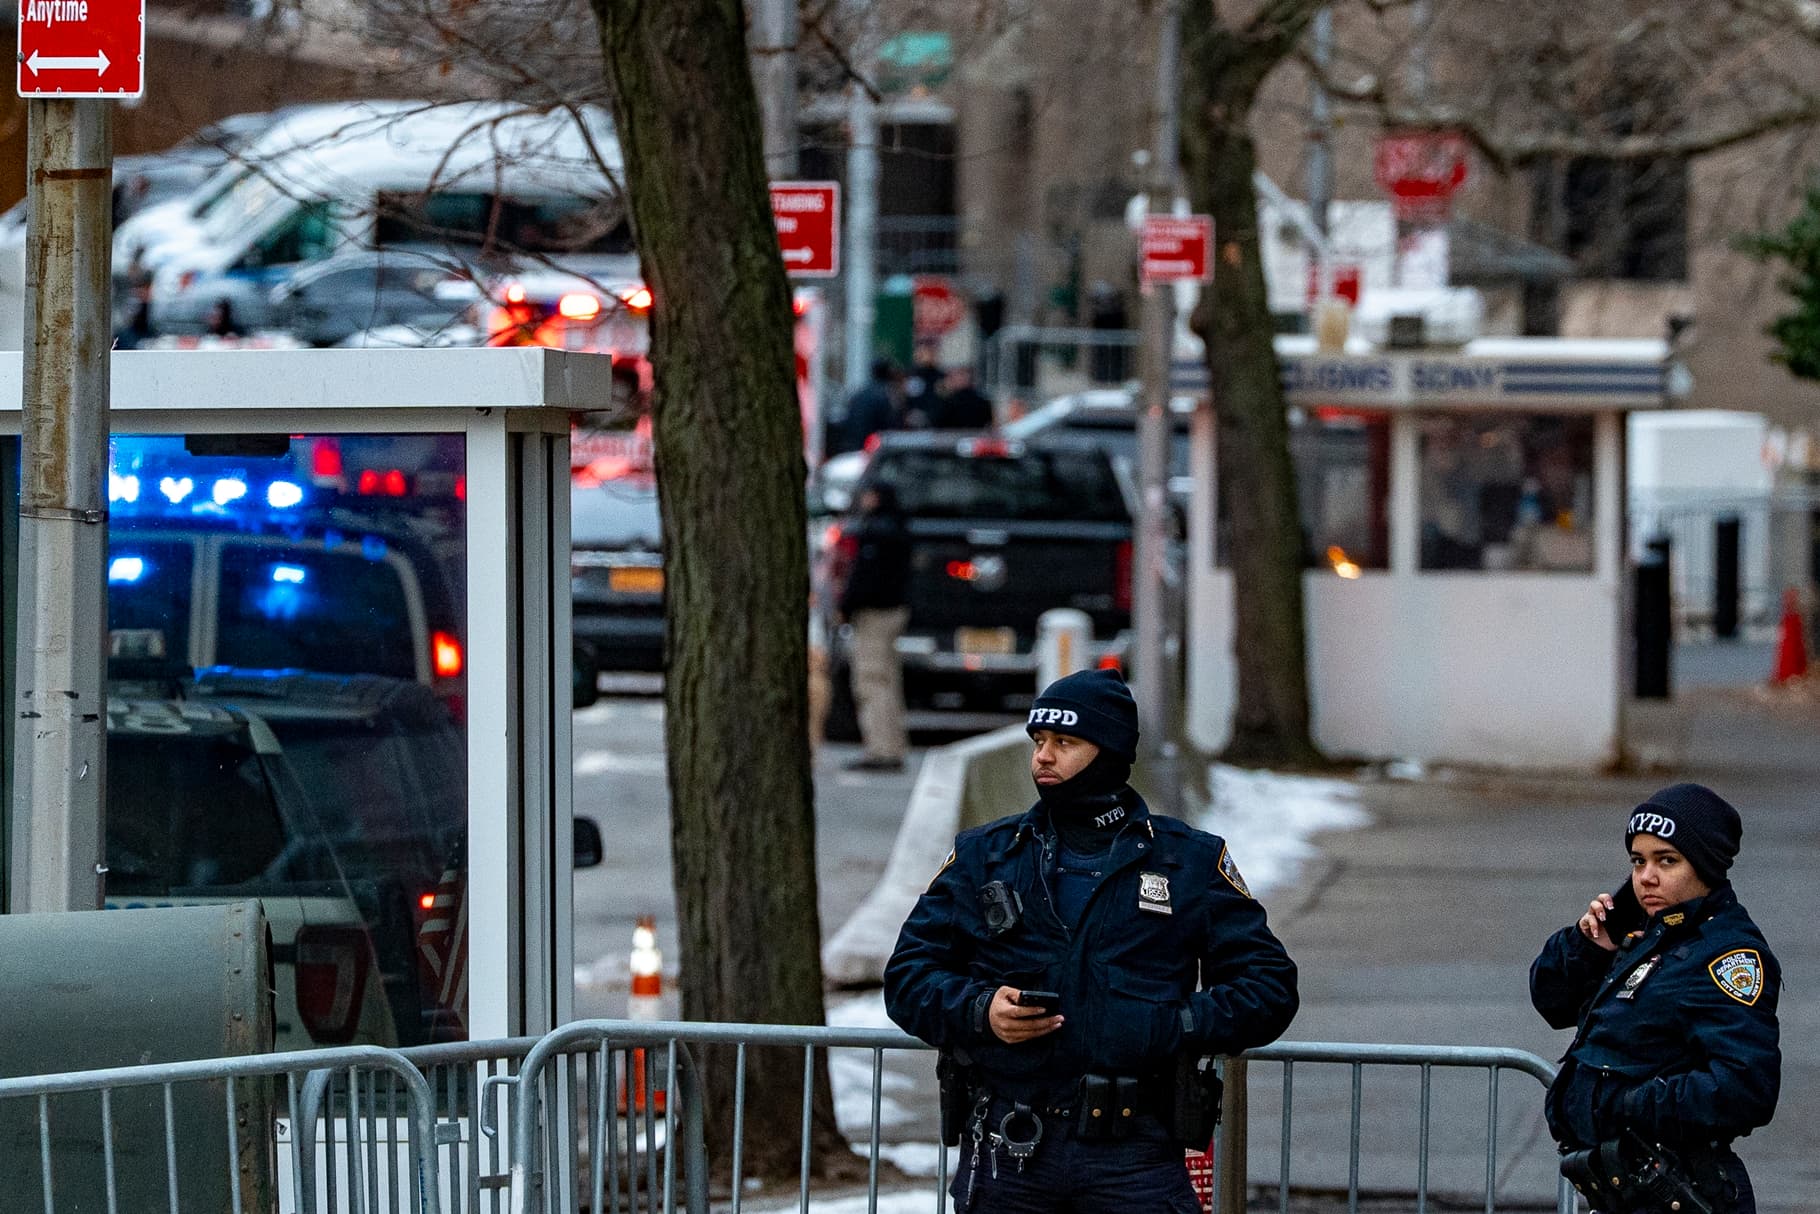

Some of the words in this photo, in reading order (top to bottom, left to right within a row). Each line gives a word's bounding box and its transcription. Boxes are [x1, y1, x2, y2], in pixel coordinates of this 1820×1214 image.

[26, 0, 88, 28] Anytime
[1094, 806, 1125, 828] NYPD
[1716, 958, 1757, 976] DEPARTMENT
[1722, 953, 1746, 965] POLICE
[1720, 980, 1734, 992] CITY
[1733, 990, 1743, 998] OF
